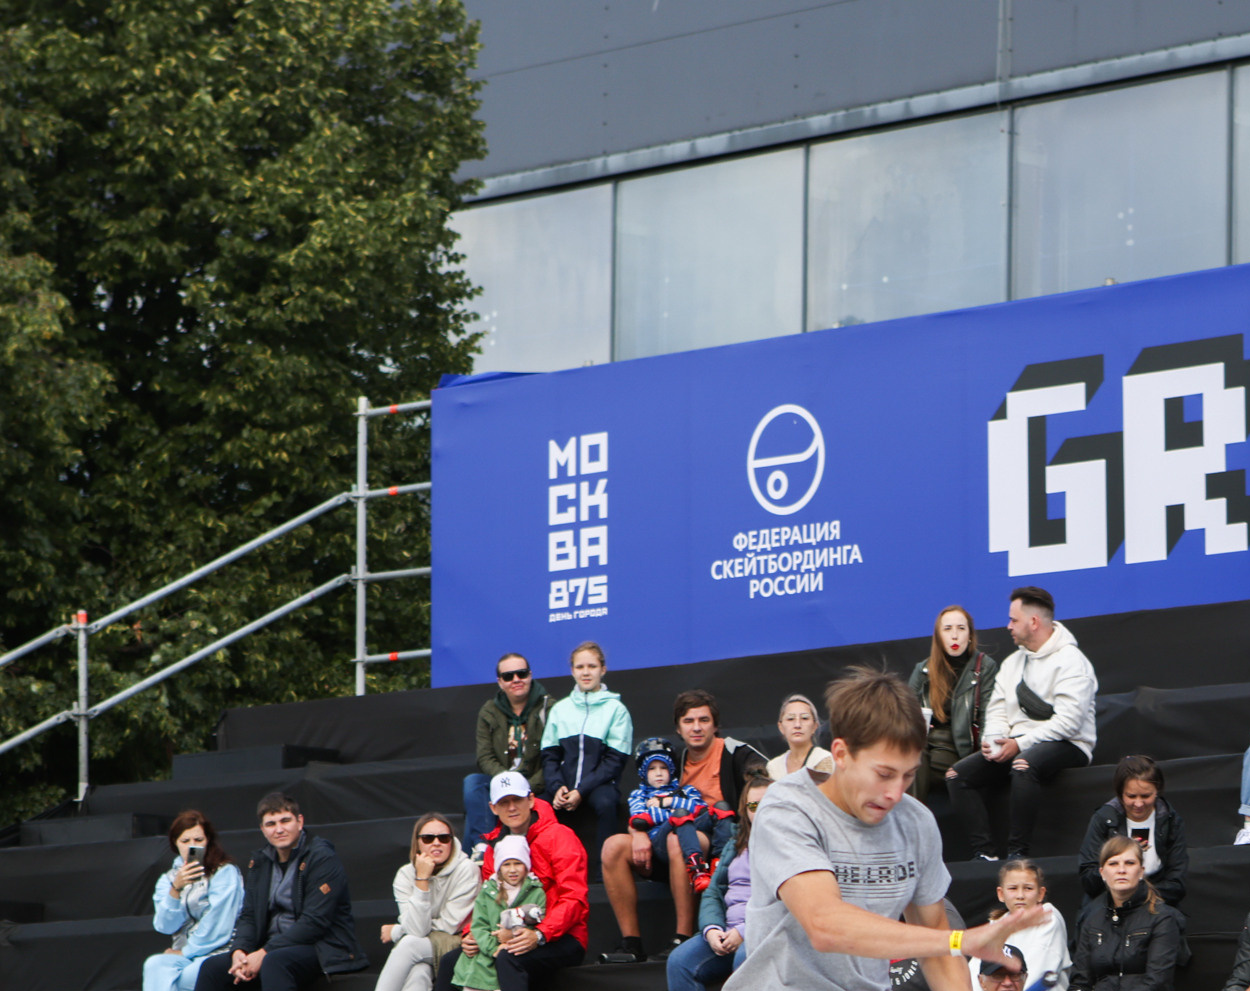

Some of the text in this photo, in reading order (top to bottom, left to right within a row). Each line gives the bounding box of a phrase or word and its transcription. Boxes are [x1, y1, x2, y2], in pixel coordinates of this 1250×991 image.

[732, 520, 841, 552] ФЕДЕРАЦИЯ
[710, 544, 863, 580] СКЕЙТБОРДИНГА
[549, 574, 608, 609] 875
[749, 572, 824, 599] РОССИИ
[549, 607, 608, 622] ДЕНЬ ГОРОДА
[834, 861, 915, 884] HELRDE
